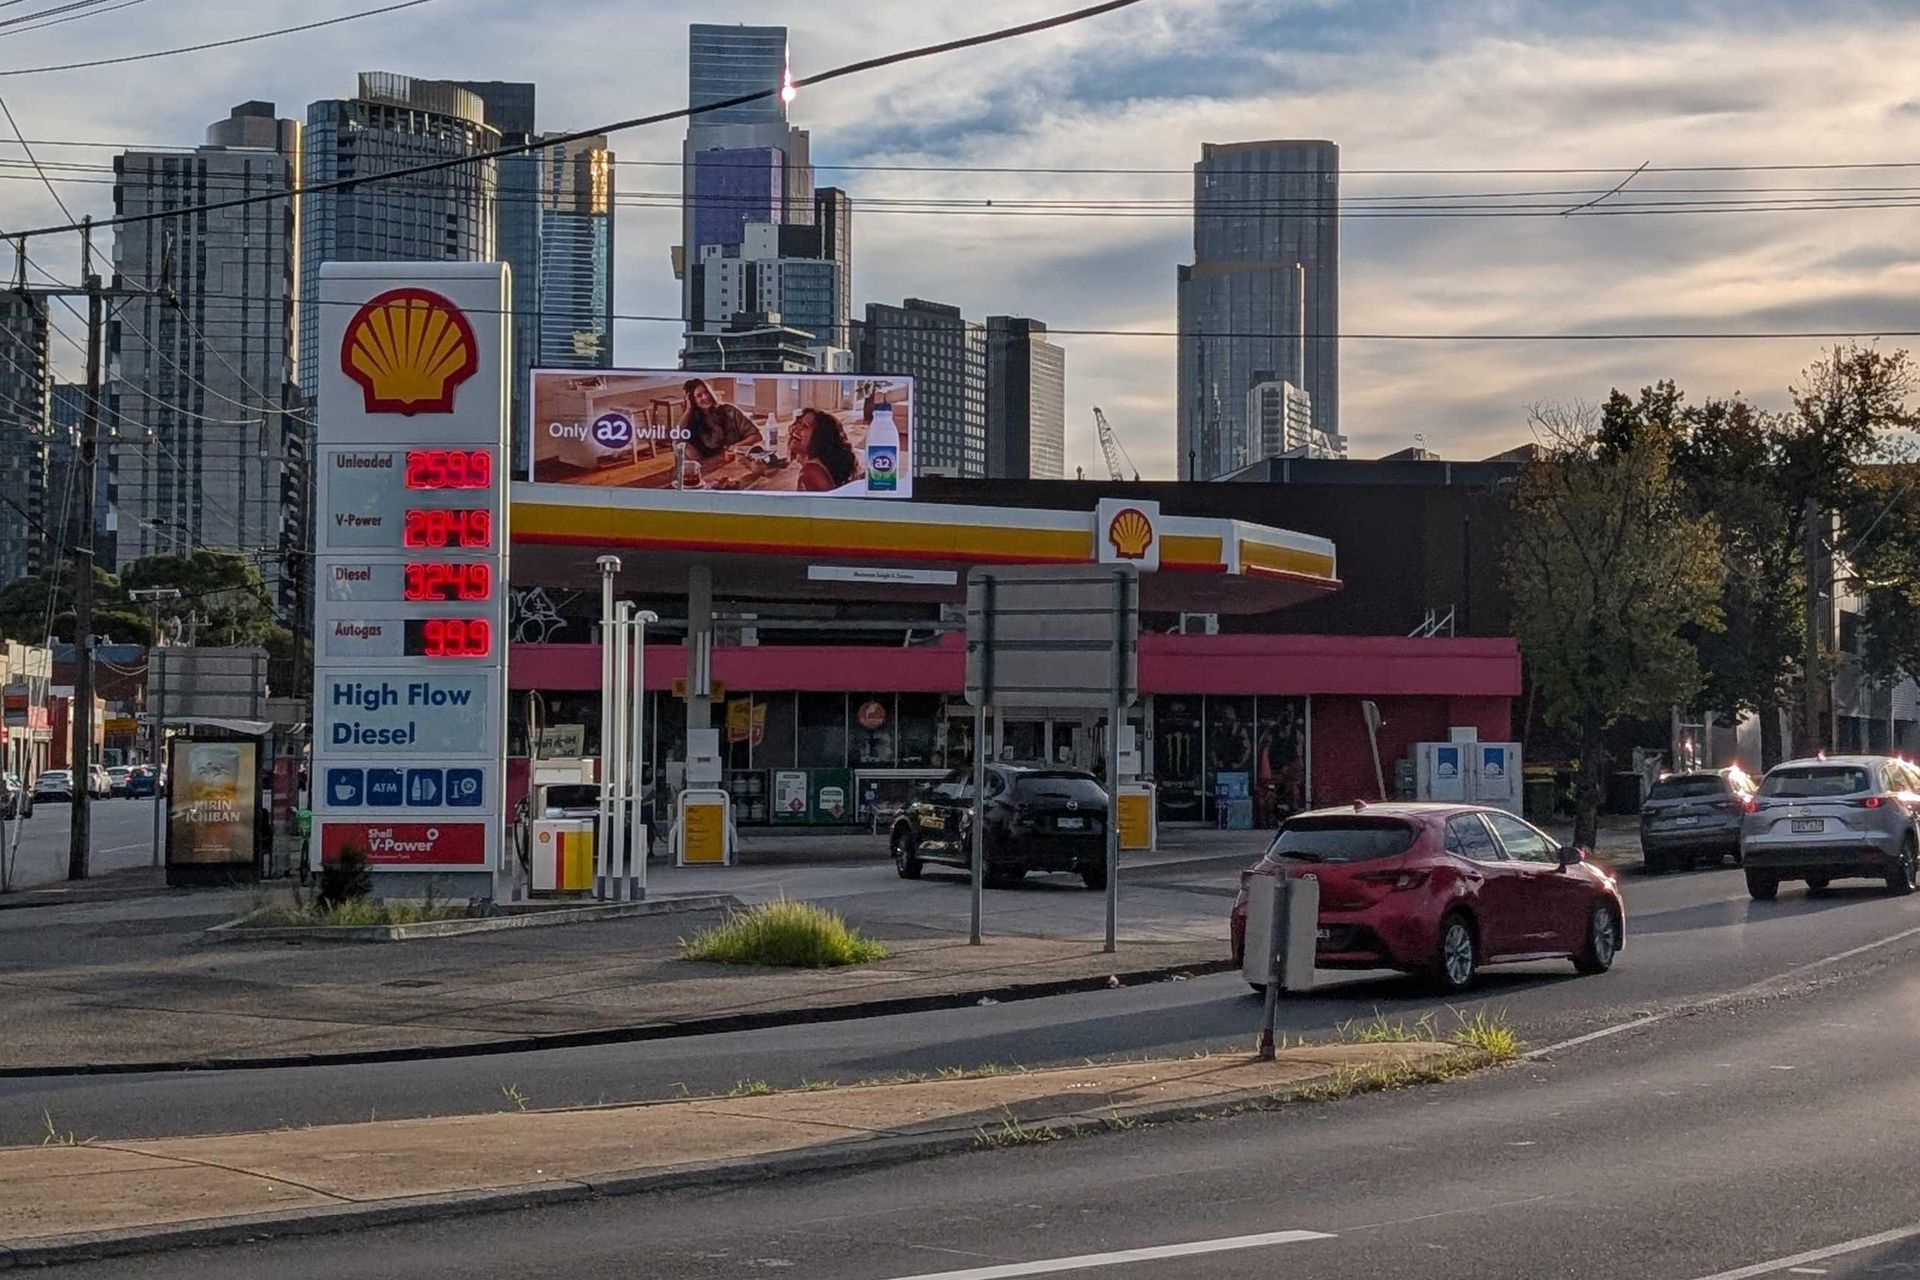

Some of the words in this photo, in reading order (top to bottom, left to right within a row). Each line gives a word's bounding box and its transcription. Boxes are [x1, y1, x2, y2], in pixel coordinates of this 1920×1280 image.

[548, 422, 587, 440] Only
[596, 420, 629, 441] a2
[637, 425, 665, 440] will
[670, 425, 691, 441] do
[337, 454, 392, 469] Unleaded
[405, 451, 491, 488] 259.9
[874, 458, 890, 469] a2
[336, 514, 382, 527] V-Power
[404, 510, 491, 547] 284.9
[335, 566, 371, 581] Diesel
[404, 563, 491, 601] 324.9
[335, 622, 382, 639] Autogas
[424, 619, 491, 657] 99.9
[333, 683, 398, 711] High
[408, 683, 471, 706] Flow
[333, 722, 415, 745] Diesel
[372, 781, 397, 793] ATM
[194, 800, 232, 811] KIRIN
[185, 812, 240, 823] ICHIBAN
[368, 829, 393, 838] Shell
[369, 839, 433, 851] V-Power
